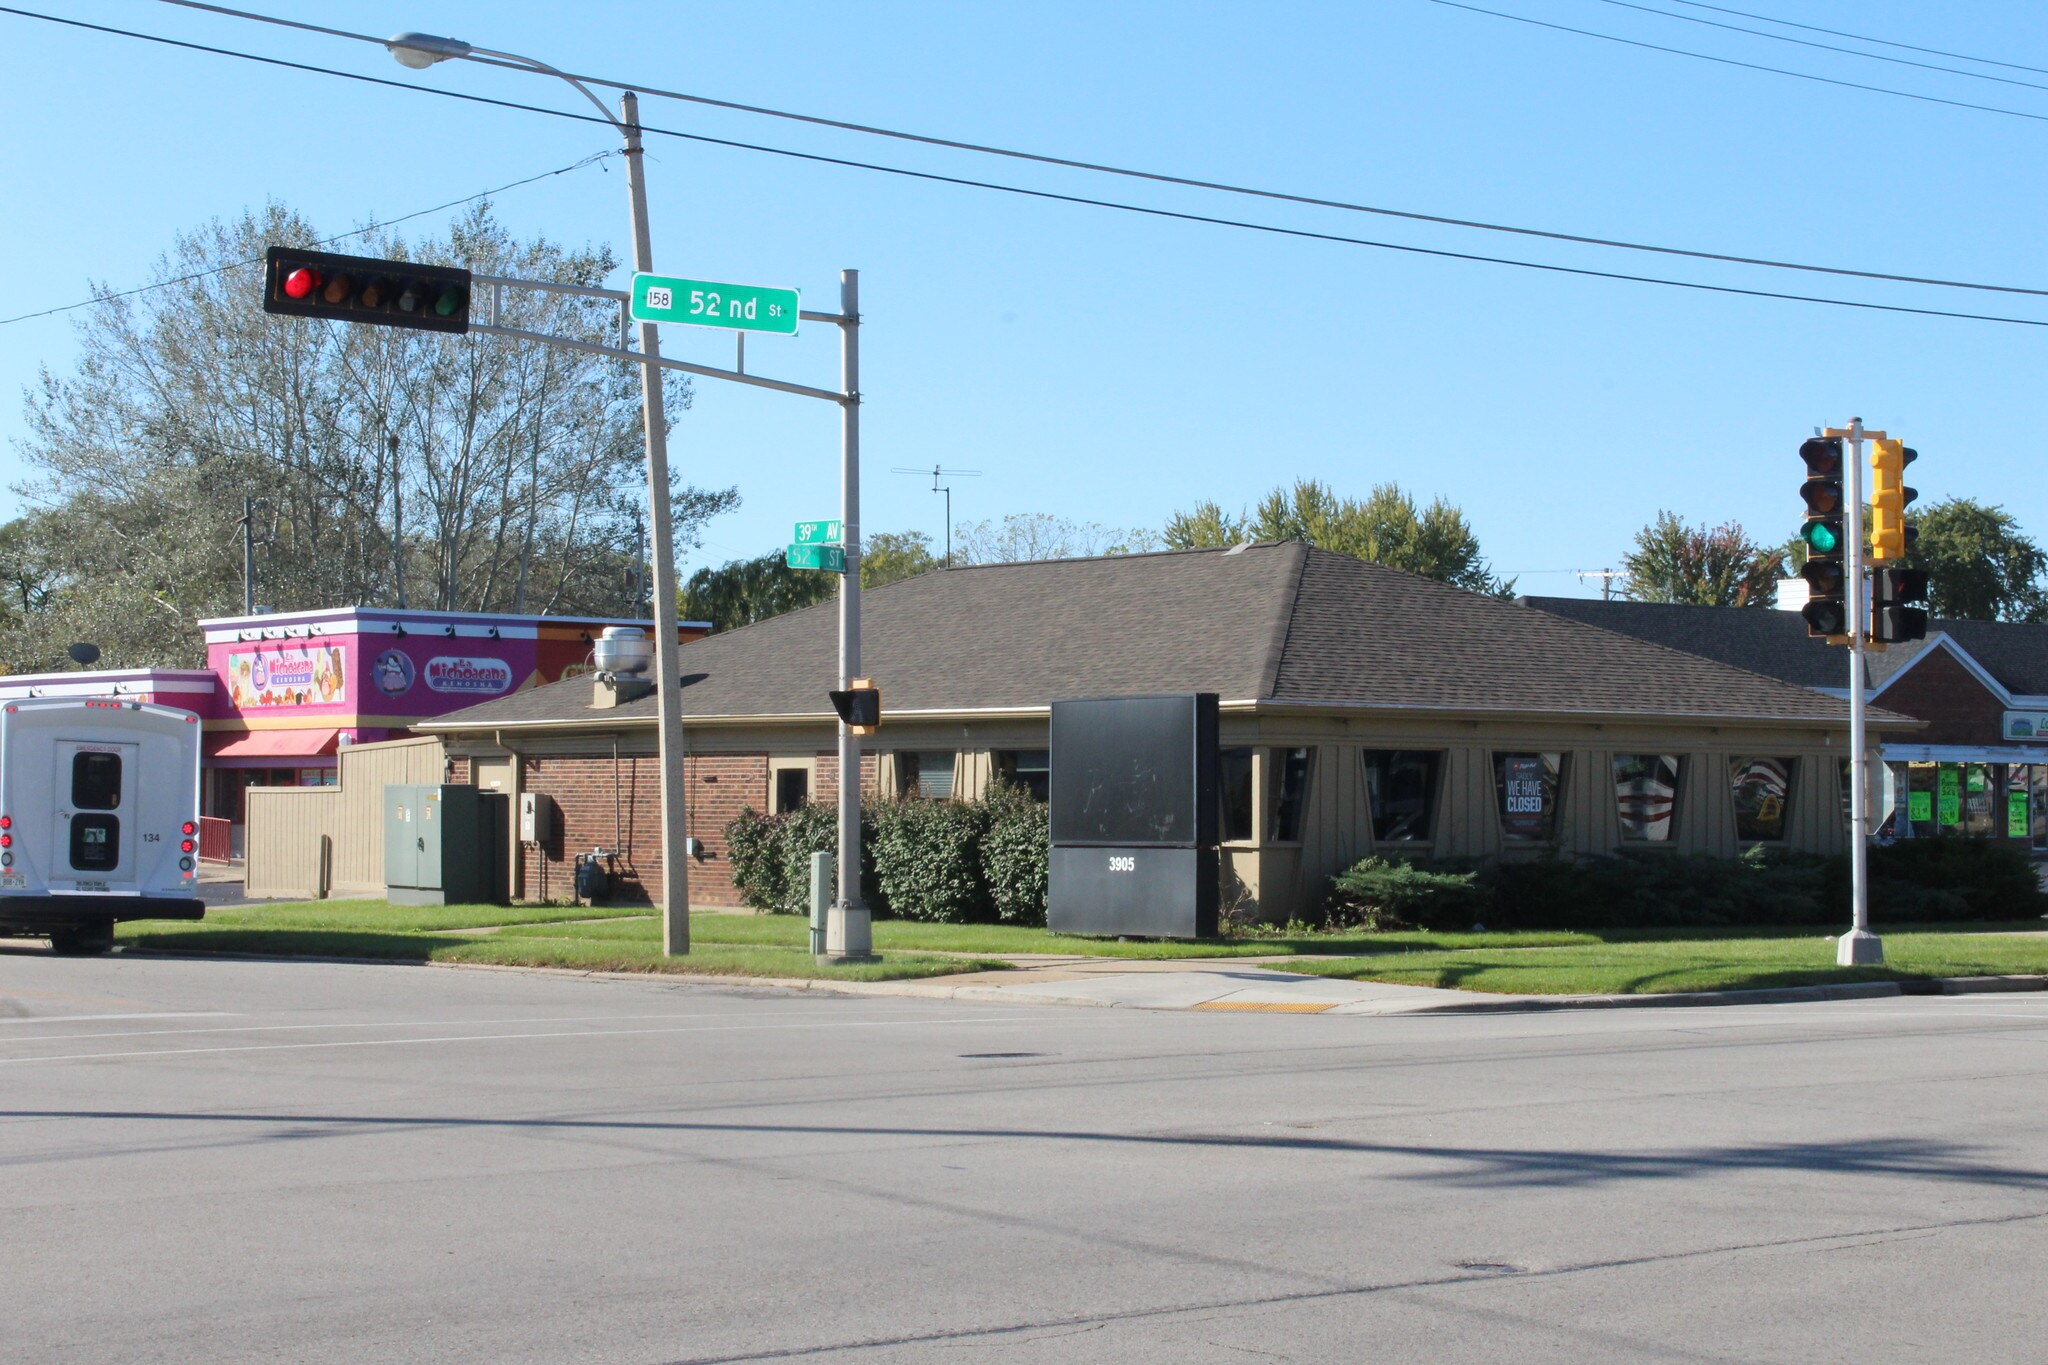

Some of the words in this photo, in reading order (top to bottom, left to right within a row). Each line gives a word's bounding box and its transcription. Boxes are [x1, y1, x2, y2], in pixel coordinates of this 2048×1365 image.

[649, 292, 669, 306] 158
[689, 290, 721, 316] 52
[729, 297, 757, 320] nd
[768, 304, 782, 317] St
[826, 522, 838, 540] AV
[828, 550, 841, 567] ST
[269, 659, 314, 675] Michoacana
[429, 662, 507, 680] Michoacana
[459, 659, 473, 668] La
[1507, 780, 1520, 796] WE
[1521, 780, 1542, 796] HAVE
[1507, 797, 1542, 812] CLOSED
[143, 833, 160, 842] 134
[1108, 856, 1135, 872] 3905
